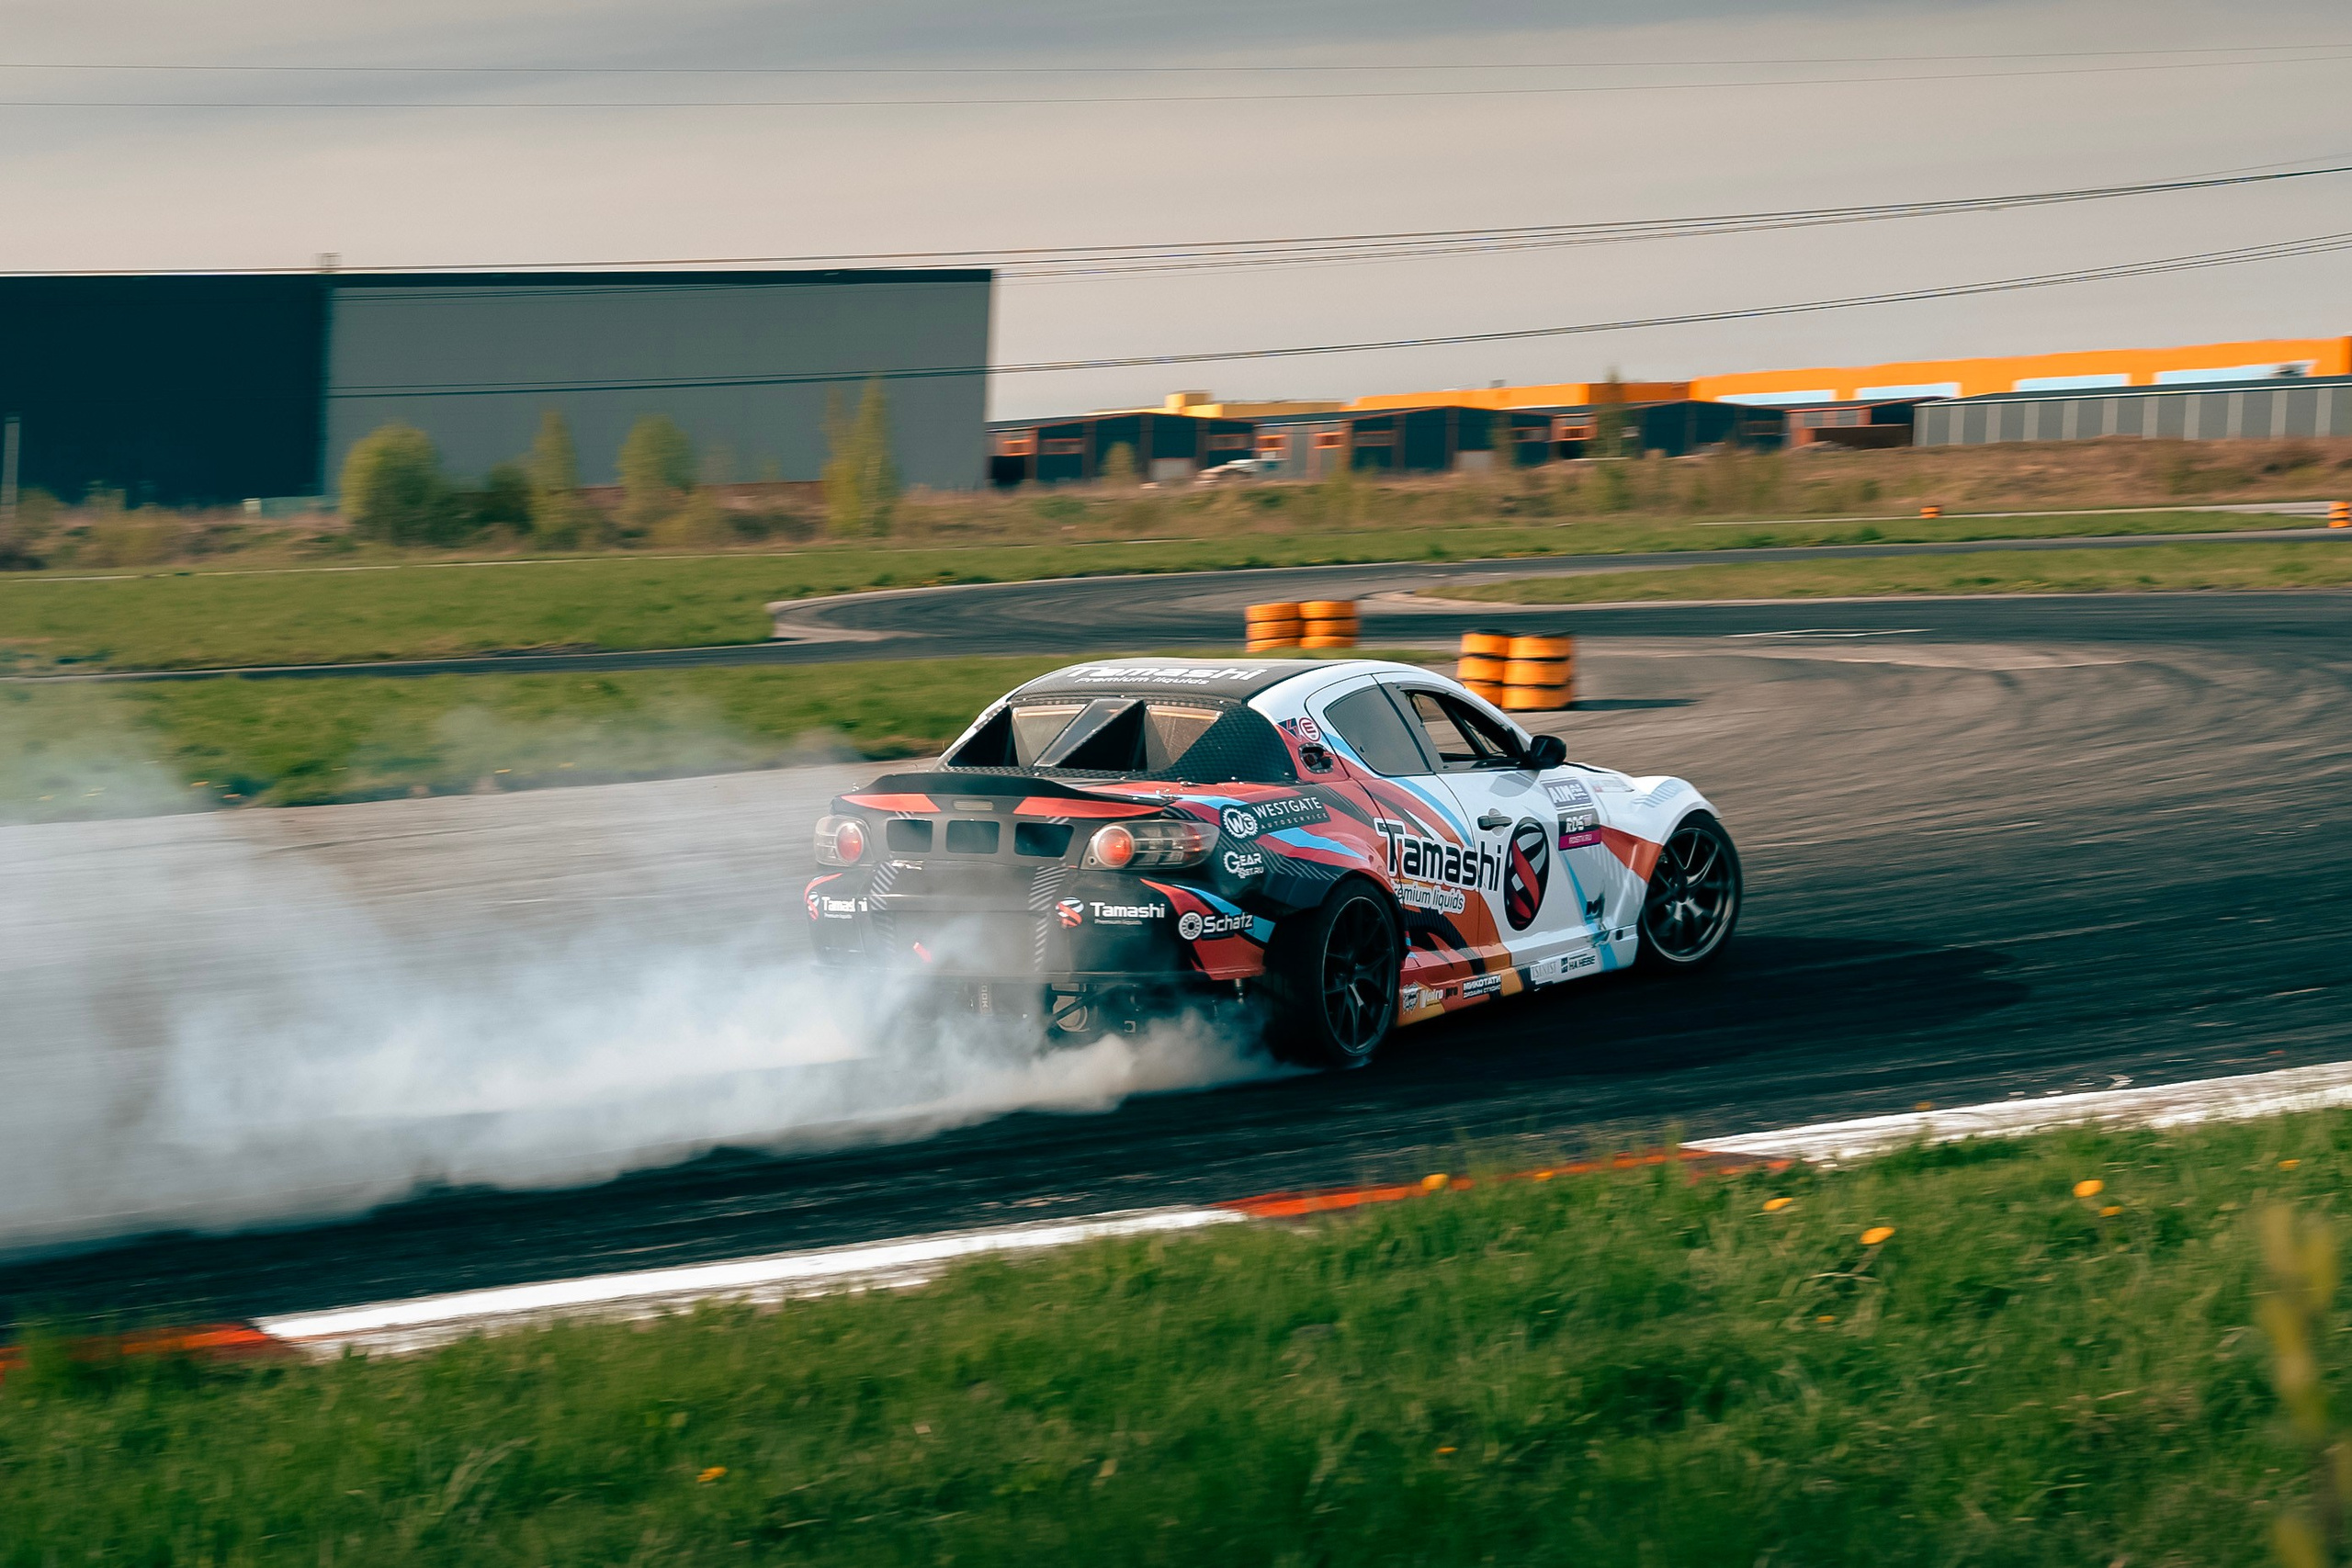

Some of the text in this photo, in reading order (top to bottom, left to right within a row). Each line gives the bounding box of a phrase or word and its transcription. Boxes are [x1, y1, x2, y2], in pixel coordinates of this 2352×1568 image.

[1067, 666, 1267, 681] Tamashi
[1252, 796, 1322, 819] WESTGATE
[1261, 812, 1329, 829] AUTOSERVICE
[1376, 821, 1502, 892] Tamashi
[1395, 881, 1463, 910] emium liquids
[1090, 902, 1165, 919] Tamashi
[1203, 912, 1253, 933] Schatz
